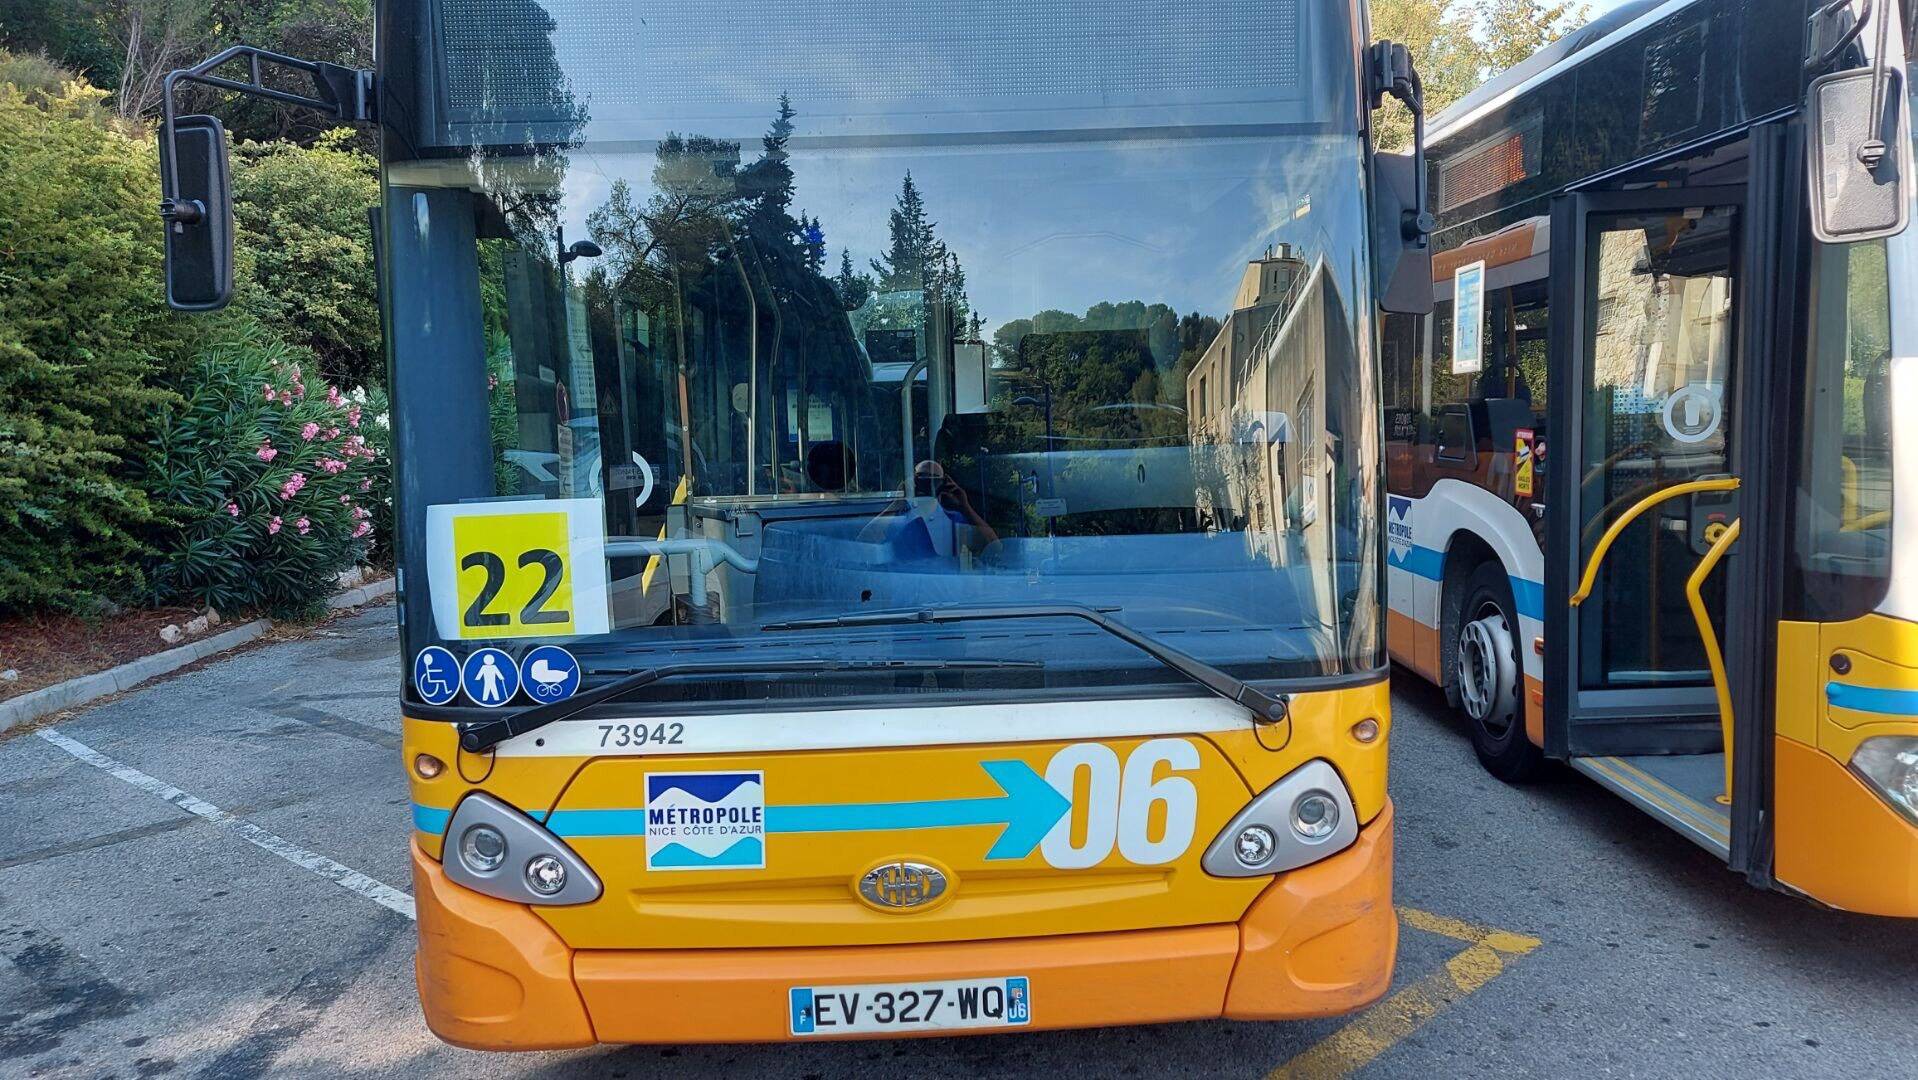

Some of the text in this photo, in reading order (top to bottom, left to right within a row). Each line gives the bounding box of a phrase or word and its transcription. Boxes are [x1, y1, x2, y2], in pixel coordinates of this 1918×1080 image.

[461, 548, 570, 627] 22
[598, 722, 685, 748] 73942
[649, 803, 762, 825] MÉTROPOLE
[1040, 738, 1201, 870] 06
[649, 824, 762, 836] NICE CÔTE D'AZUR
[814, 986, 1005, 1027] EV-327-WQ
